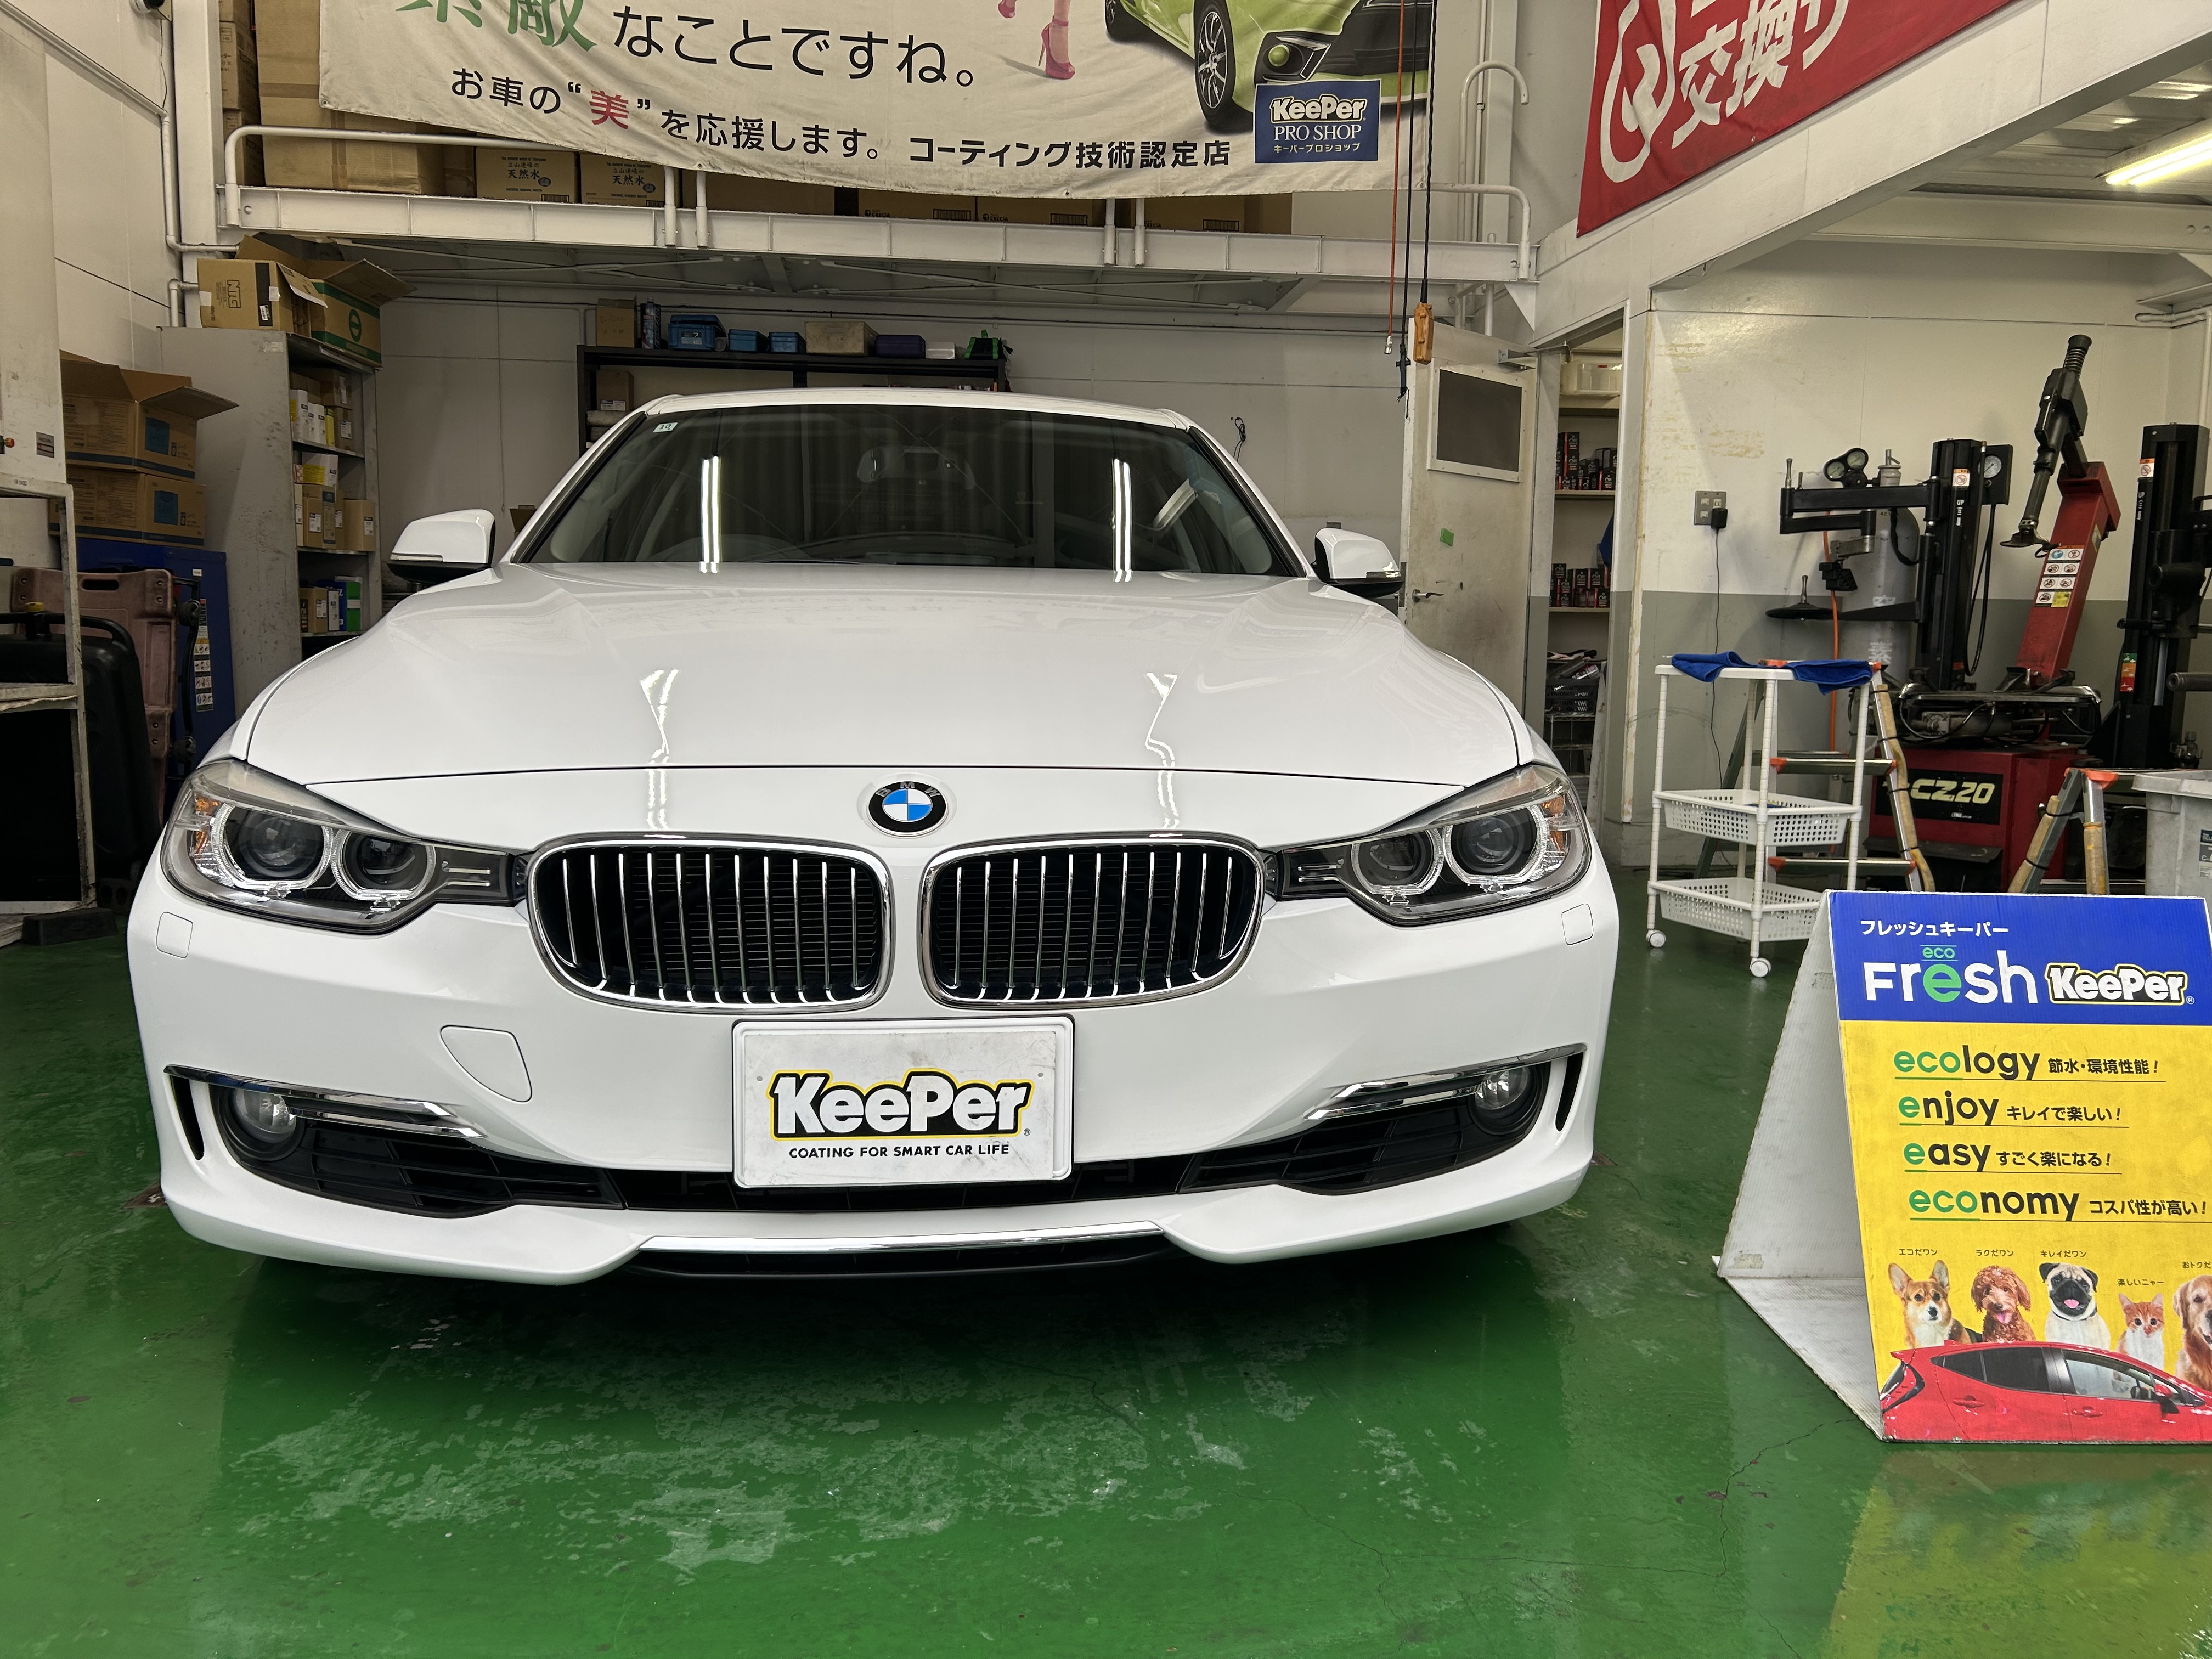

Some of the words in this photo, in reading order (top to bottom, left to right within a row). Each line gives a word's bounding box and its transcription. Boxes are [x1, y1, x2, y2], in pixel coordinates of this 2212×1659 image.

[1270, 94, 1367, 122] KeePer
[1273, 125, 1310, 141] PRO
[1313, 124, 1362, 141] SHOP
[910, 137, 1231, 169] コーティング技術認定店
[507, 169, 540, 179] 天然水
[612, 175, 645, 185] 天然水
[876, 782, 941, 798] BMW
[1860, 919, 2009, 938] フレッシュキーパー
[1922, 946, 1955, 959] eco
[1864, 950, 2038, 1004] Fresh
[2047, 964, 2187, 1003] KeePer
[1894, 1045, 2040, 1080] ecology
[771, 1073, 1031, 1136] KeePer
[1898, 1090, 1999, 1125] enjoy
[789, 1147, 854, 1159] COATING
[860, 1146, 888, 1158] FOR
[893, 1145, 940, 1157] SMART
[945, 1144, 973, 1156] CAR
[978, 1144, 1009, 1155] LIFE
[1904, 1141, 1991, 1173] easy
[1909, 1189, 2080, 1221] economy
[1899, 1248, 1938, 1257] エコだワン
[1975, 1249, 2015, 1258] ラクだワン
[2040, 1249, 2087, 1259] キレイだワン
[2117, 1278, 2165, 1286] 楽しいニャー
